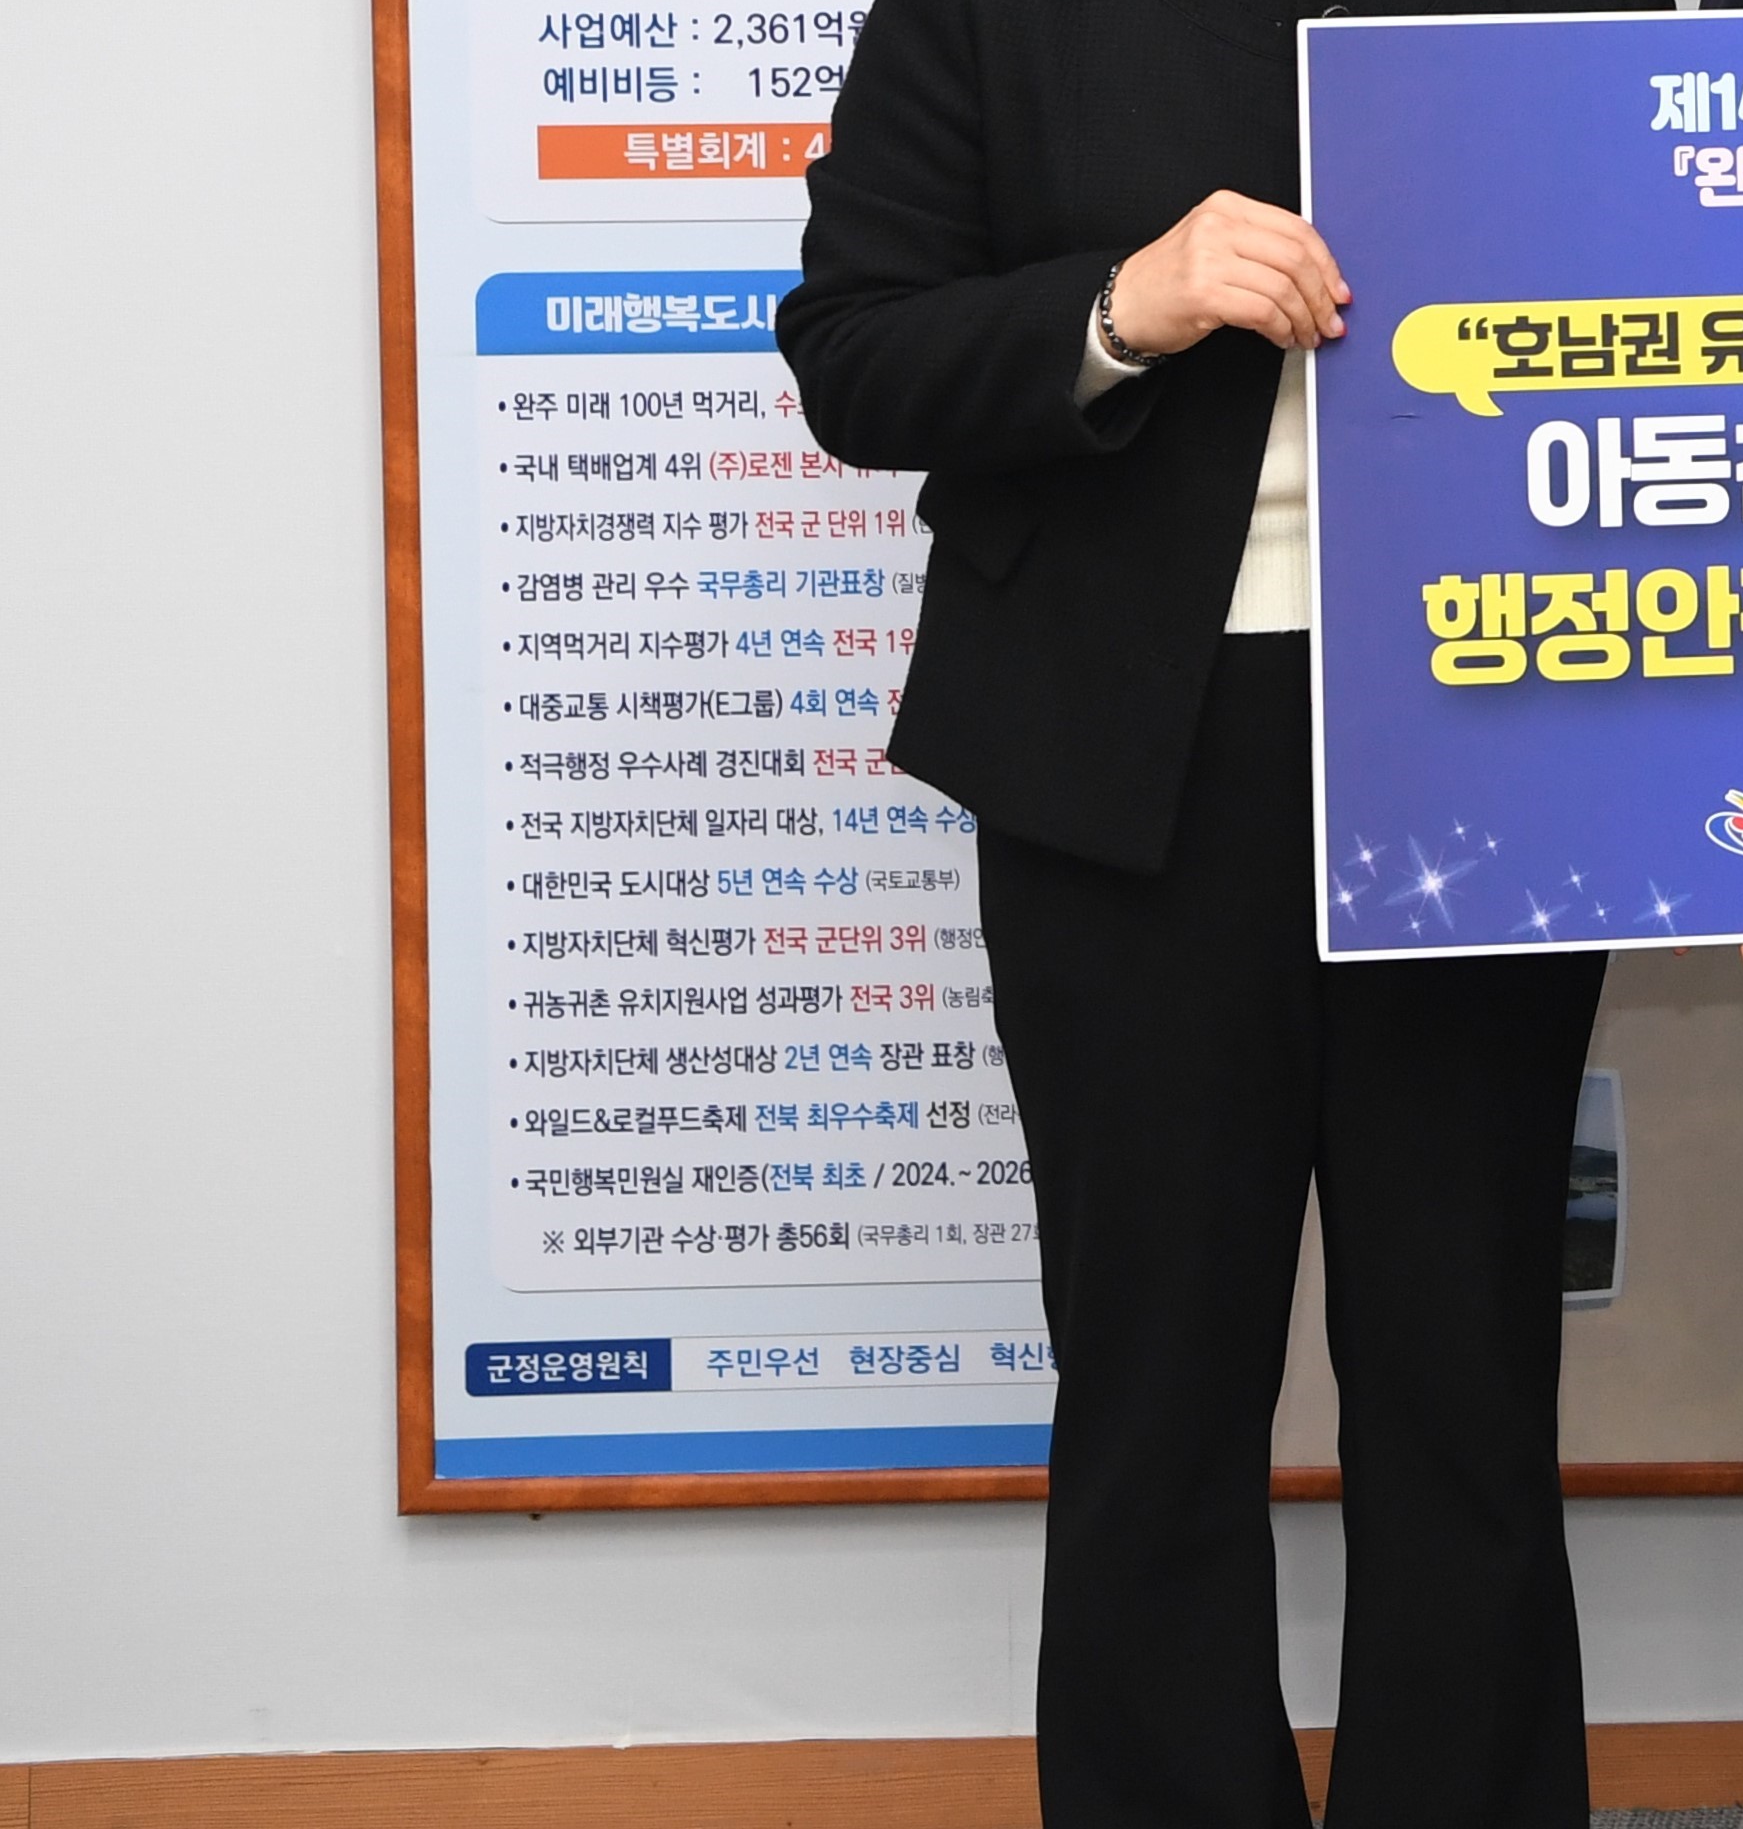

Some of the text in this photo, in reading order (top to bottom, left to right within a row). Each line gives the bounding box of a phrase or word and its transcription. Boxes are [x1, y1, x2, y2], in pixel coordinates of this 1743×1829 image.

[624, 132, 765, 170] 특별회계
[513, 390, 765, 420] 완주 미래 100년 먹거리,
[514, 452, 701, 482] 국내 택배업계 4위
[516, 511, 748, 542] 지방자치경쟁력 지수 평가
[518, 569, 885, 601] 감염병 관리 우수 국무총리 기관표창
[523, 867, 960, 900] 대한민국 도시대상 5년 연속 수상 (국토교통부)
[525, 1100, 970, 1137] 와일드&로컬푸드축제 전북 최우수축제 선정
[526, 1166, 683, 1197] 국민행복민원실
[487, 1344, 959, 1383] 군정운영원칙 주민우선 현장중심
